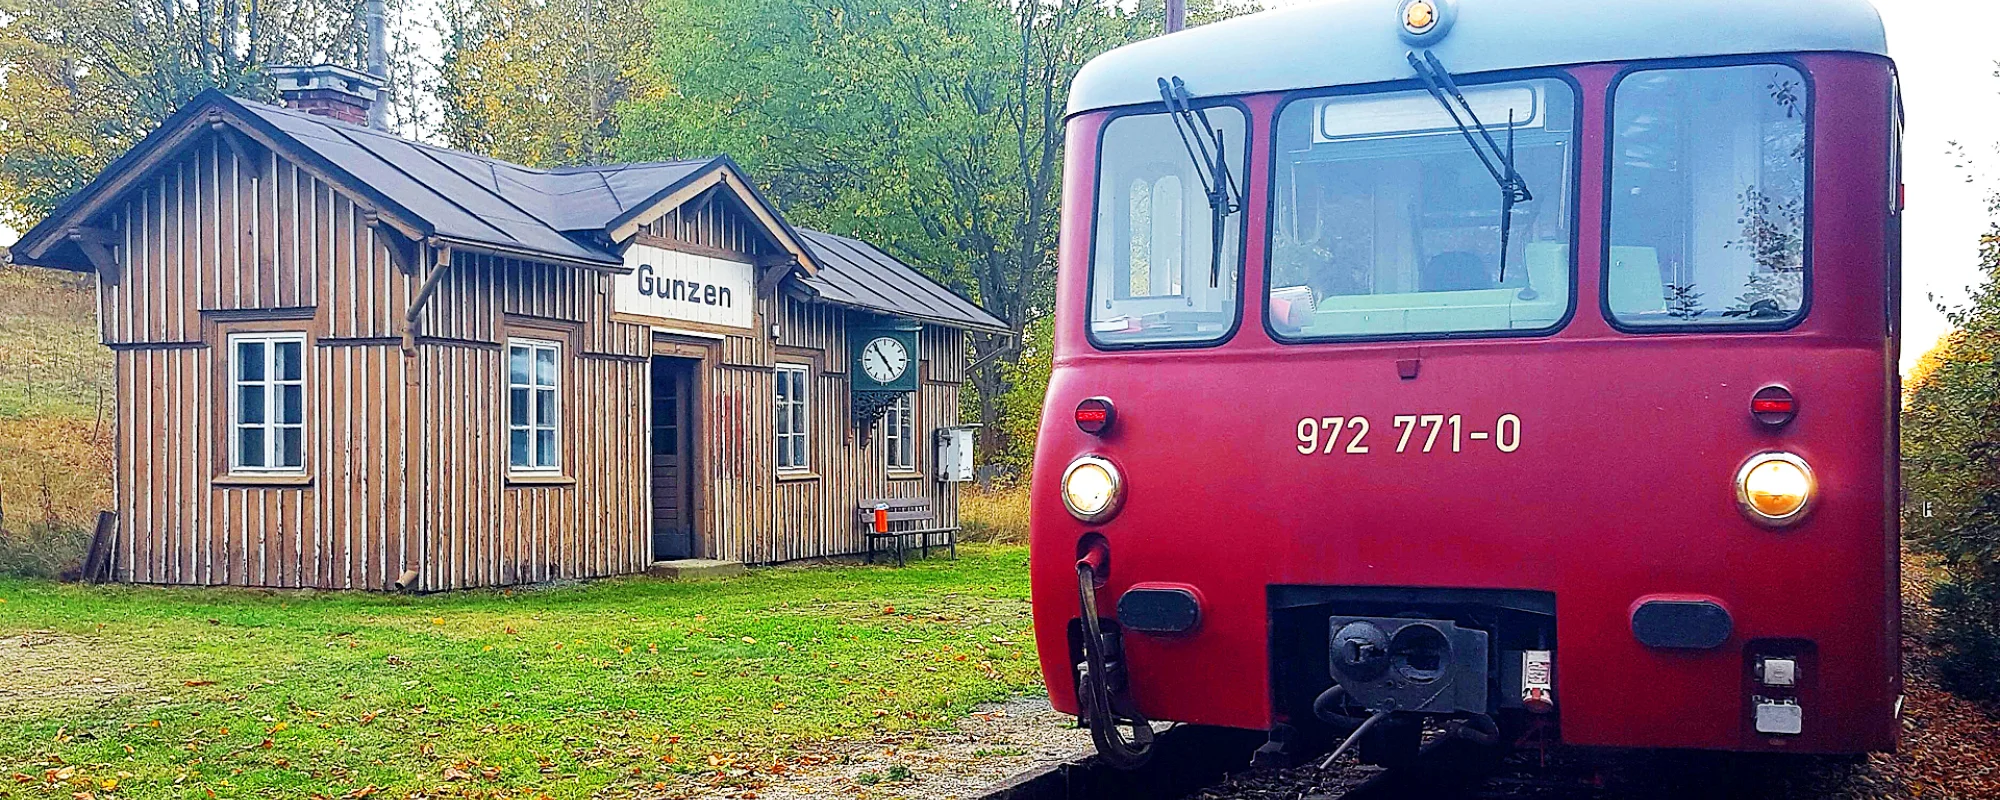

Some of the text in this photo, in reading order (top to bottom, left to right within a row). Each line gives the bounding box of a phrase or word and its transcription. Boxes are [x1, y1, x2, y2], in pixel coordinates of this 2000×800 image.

[637, 263, 732, 308] Gunzen
[1296, 413, 1522, 455] 972 771-0
